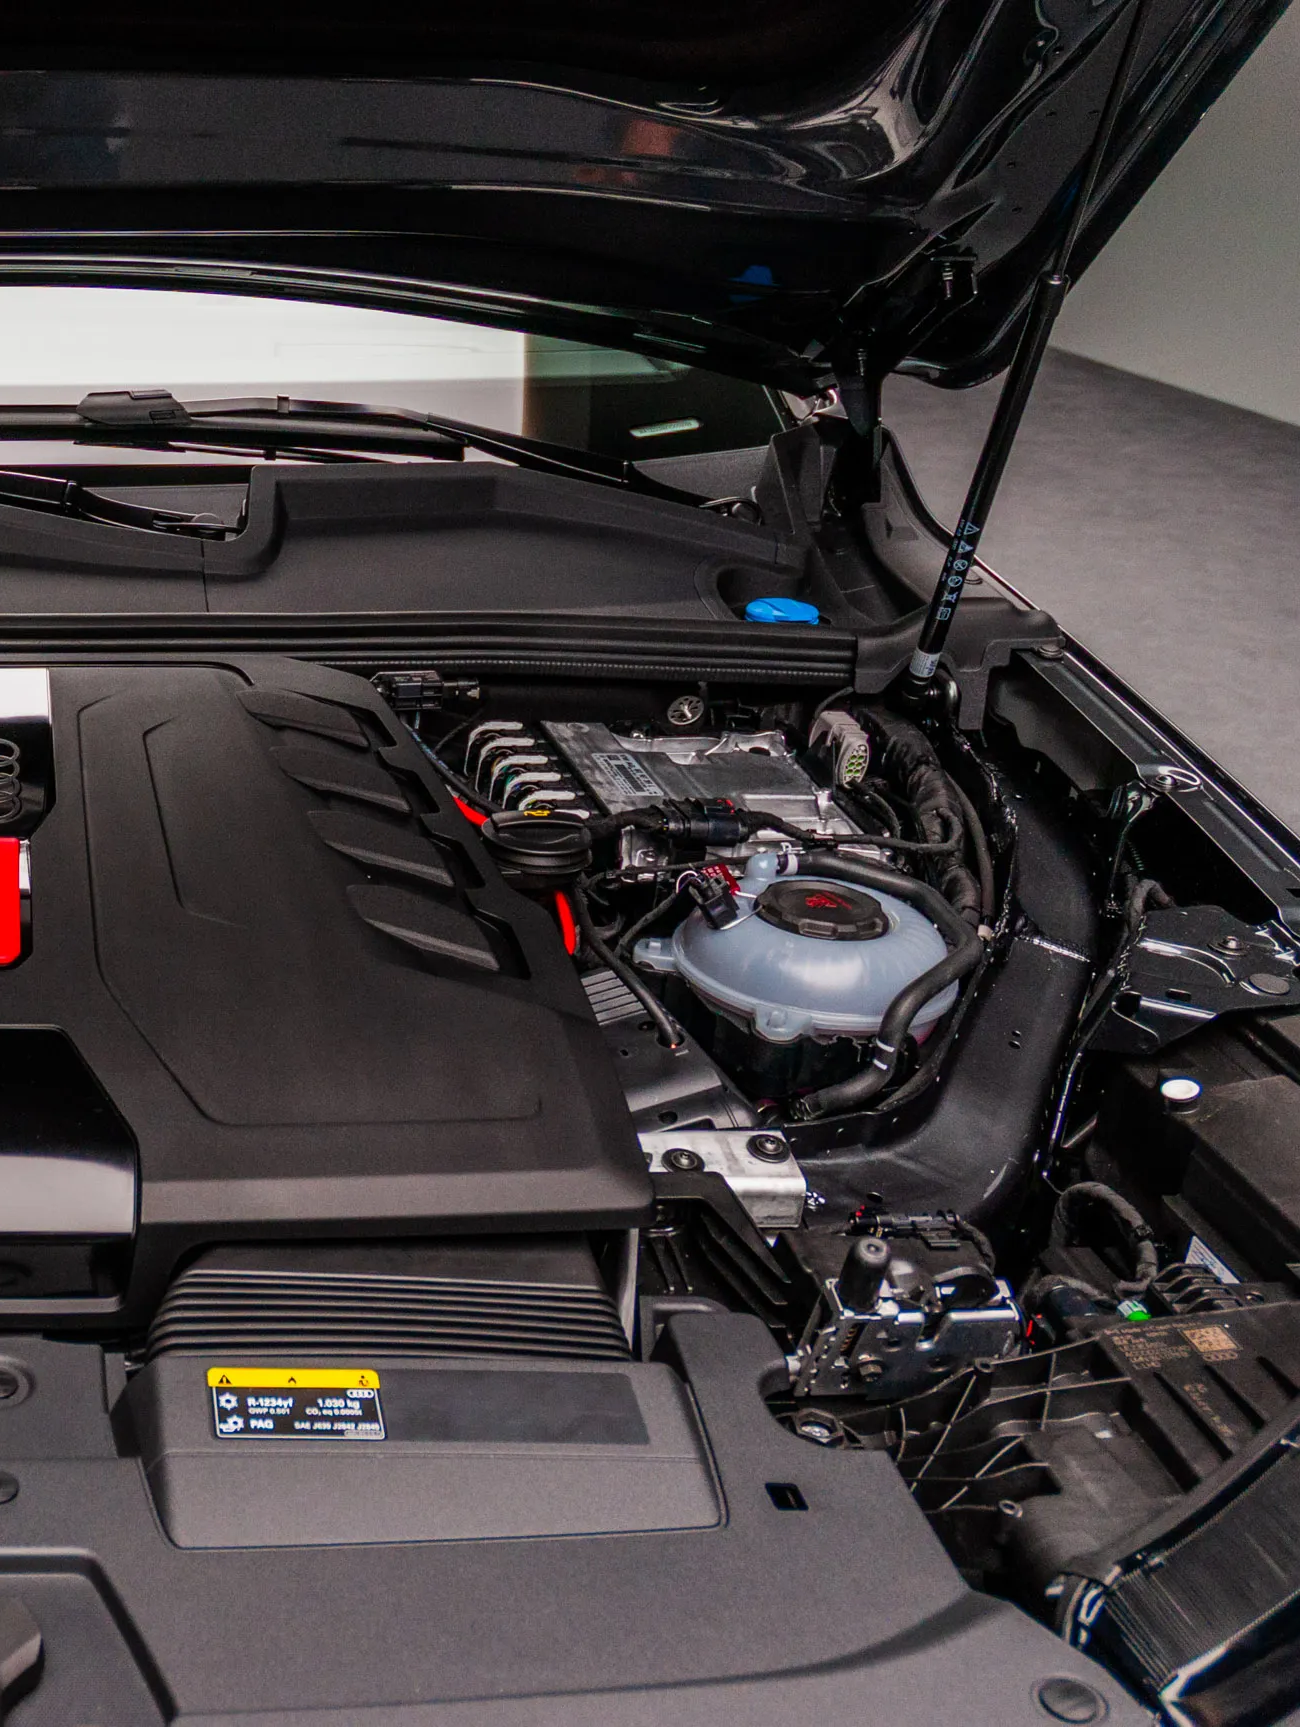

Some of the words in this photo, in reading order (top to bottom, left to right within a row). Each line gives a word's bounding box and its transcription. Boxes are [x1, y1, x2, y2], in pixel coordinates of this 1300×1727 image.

[247, 1397, 293, 1408] R-1234yf
[346, 1399, 360, 1409] kg
[249, 1418, 274, 1429] PAG
[294, 1421, 311, 1430] SAE
